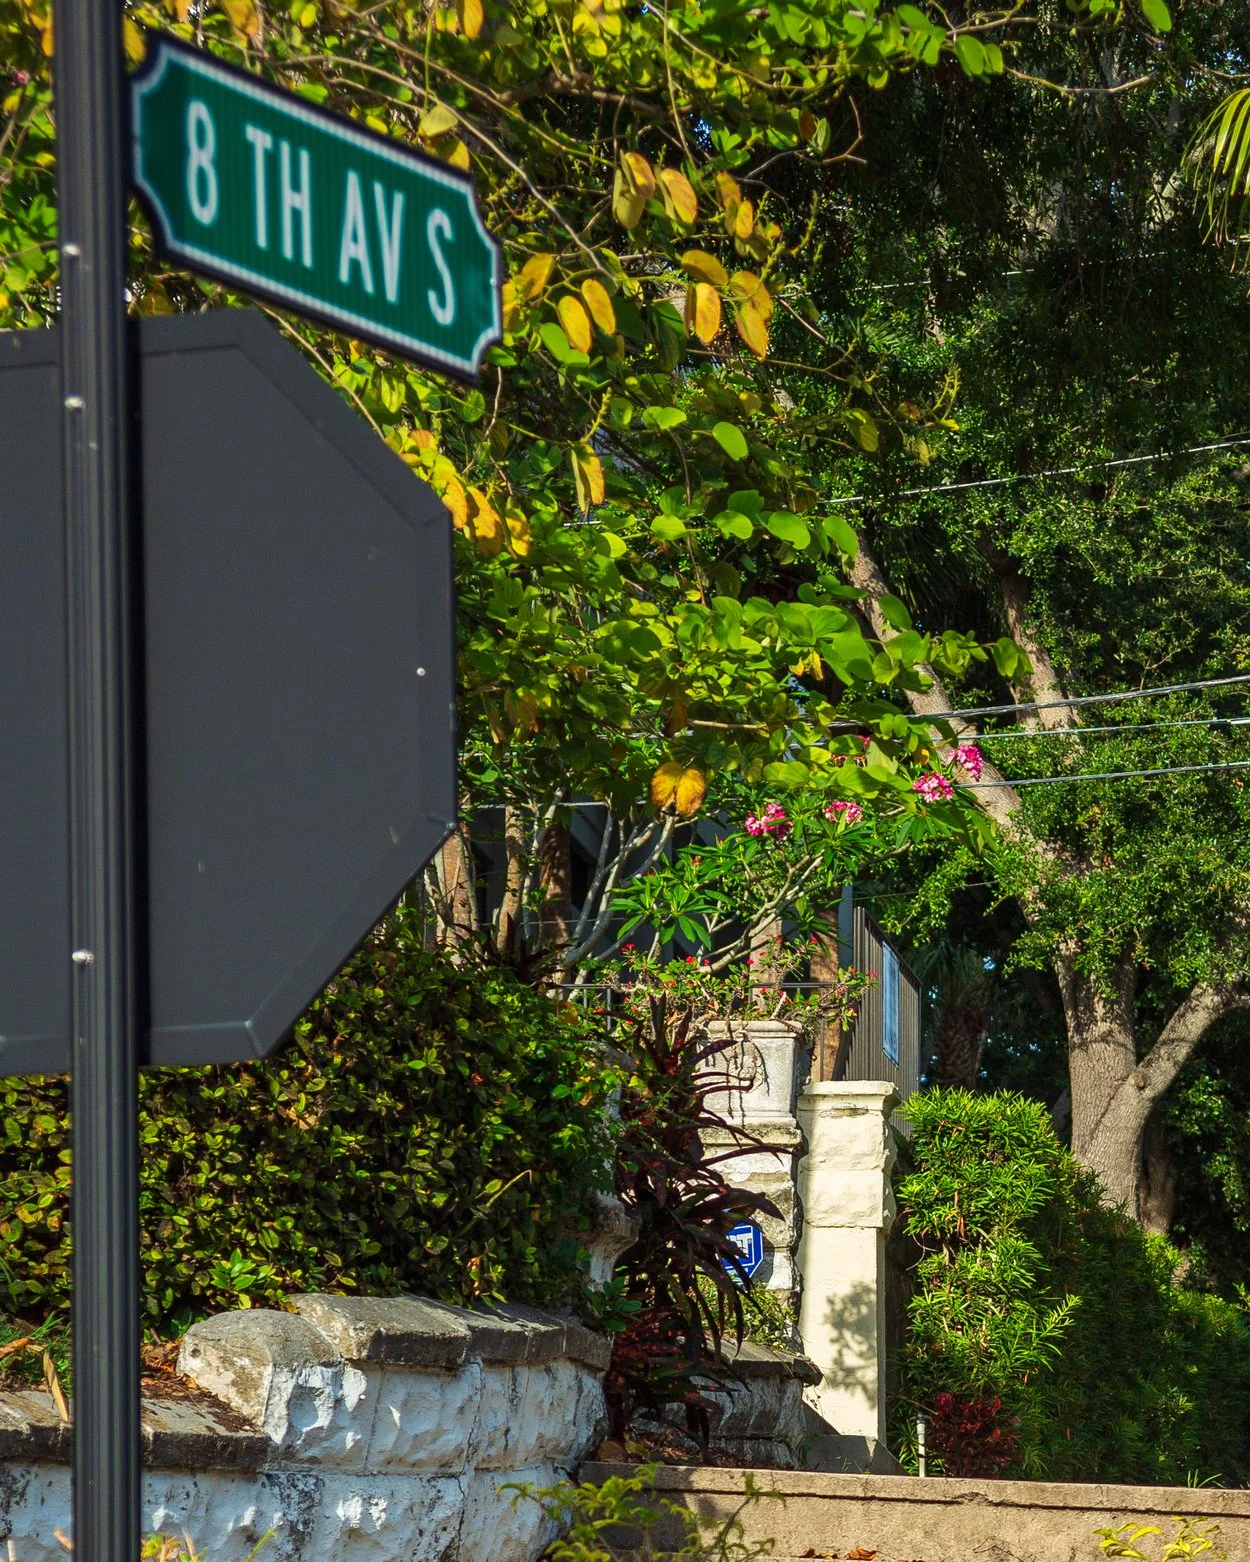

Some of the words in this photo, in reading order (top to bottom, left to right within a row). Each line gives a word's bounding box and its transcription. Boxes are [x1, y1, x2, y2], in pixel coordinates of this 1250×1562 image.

[186, 100, 219, 227] 8
[245, 123, 314, 270] TH
[339, 168, 407, 304] AV
[426, 208, 455, 327] S
